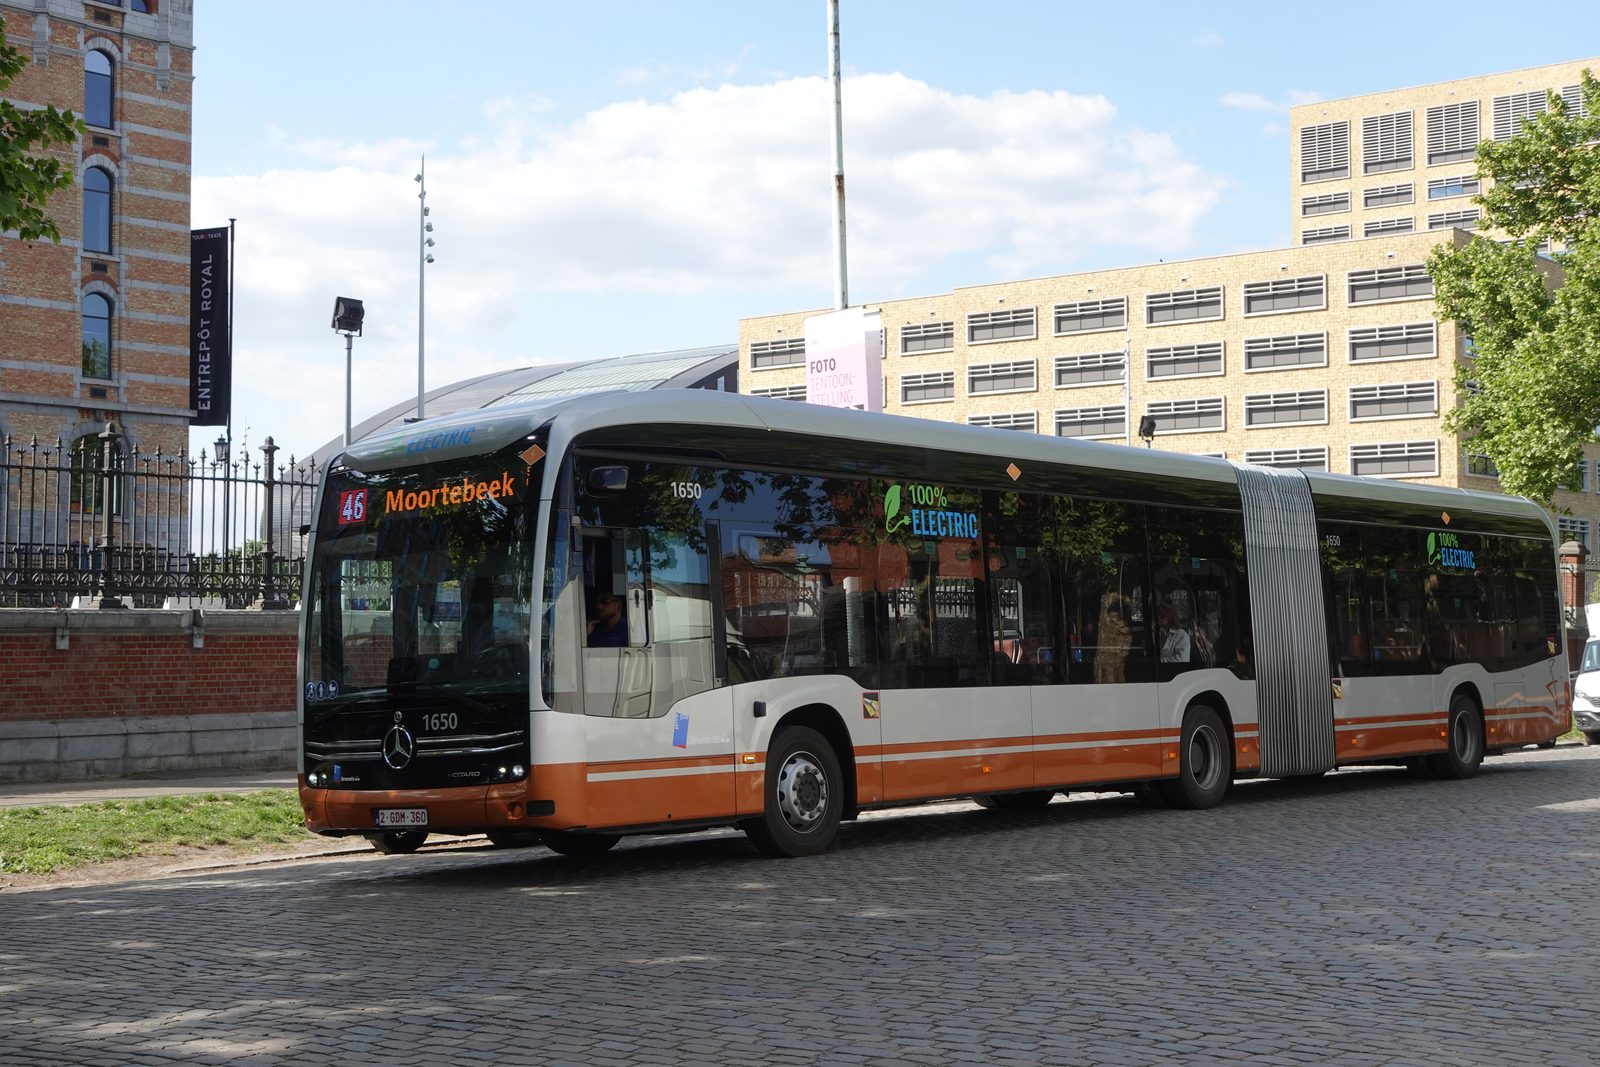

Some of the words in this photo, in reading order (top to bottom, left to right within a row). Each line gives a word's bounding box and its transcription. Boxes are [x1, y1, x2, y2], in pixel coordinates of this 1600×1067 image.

[201, 254, 212, 311] ROYAL
[197, 318, 211, 411] ENTREPÔT
[810, 358, 836, 374] FOTO
[810, 373, 857, 391] TENTOON-
[405, 426, 477, 456] ELECTRIC
[385, 471, 514, 514] Moortebeek
[670, 481, 702, 499] 1650
[908, 485, 948, 507] 100%
[342, 492, 364, 521] 46
[911, 509, 978, 538] ELECTRIC
[1325, 534, 1341, 547] 1650
[1438, 532, 1459, 548] 100%
[1441, 547, 1476, 569] ELECTRIC
[422, 712, 458, 731] 1650
